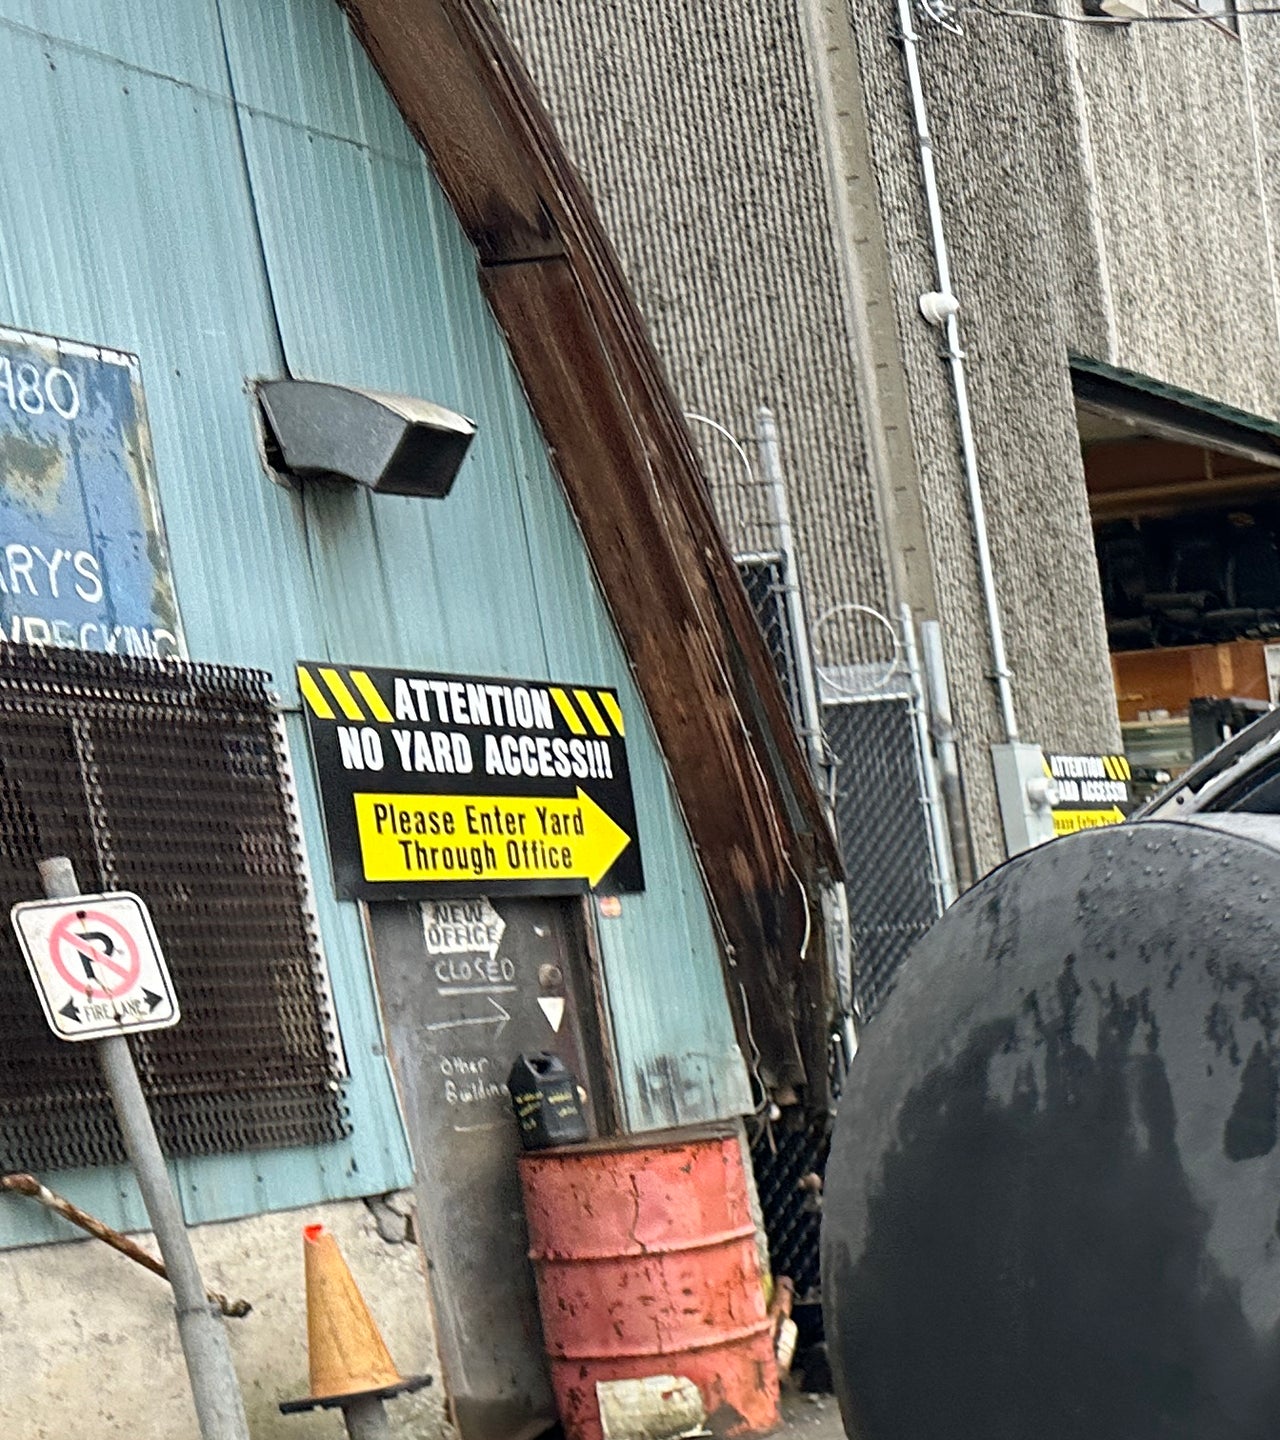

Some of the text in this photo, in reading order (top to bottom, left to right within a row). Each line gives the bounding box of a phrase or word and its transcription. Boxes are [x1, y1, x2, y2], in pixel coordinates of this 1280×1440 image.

[394, 677, 555, 730] ATTENTION
[336, 726, 613, 779] NO YARD ACCESS!!!
[373, 803, 584, 836] Please Enter Yard
[399, 840, 573, 875] Through Office
[437, 900, 485, 923] NEW
[427, 922, 500, 947] OFFICE
[434, 955, 516, 983] CLOSED
[83, 1003, 110, 1023] FIRE
